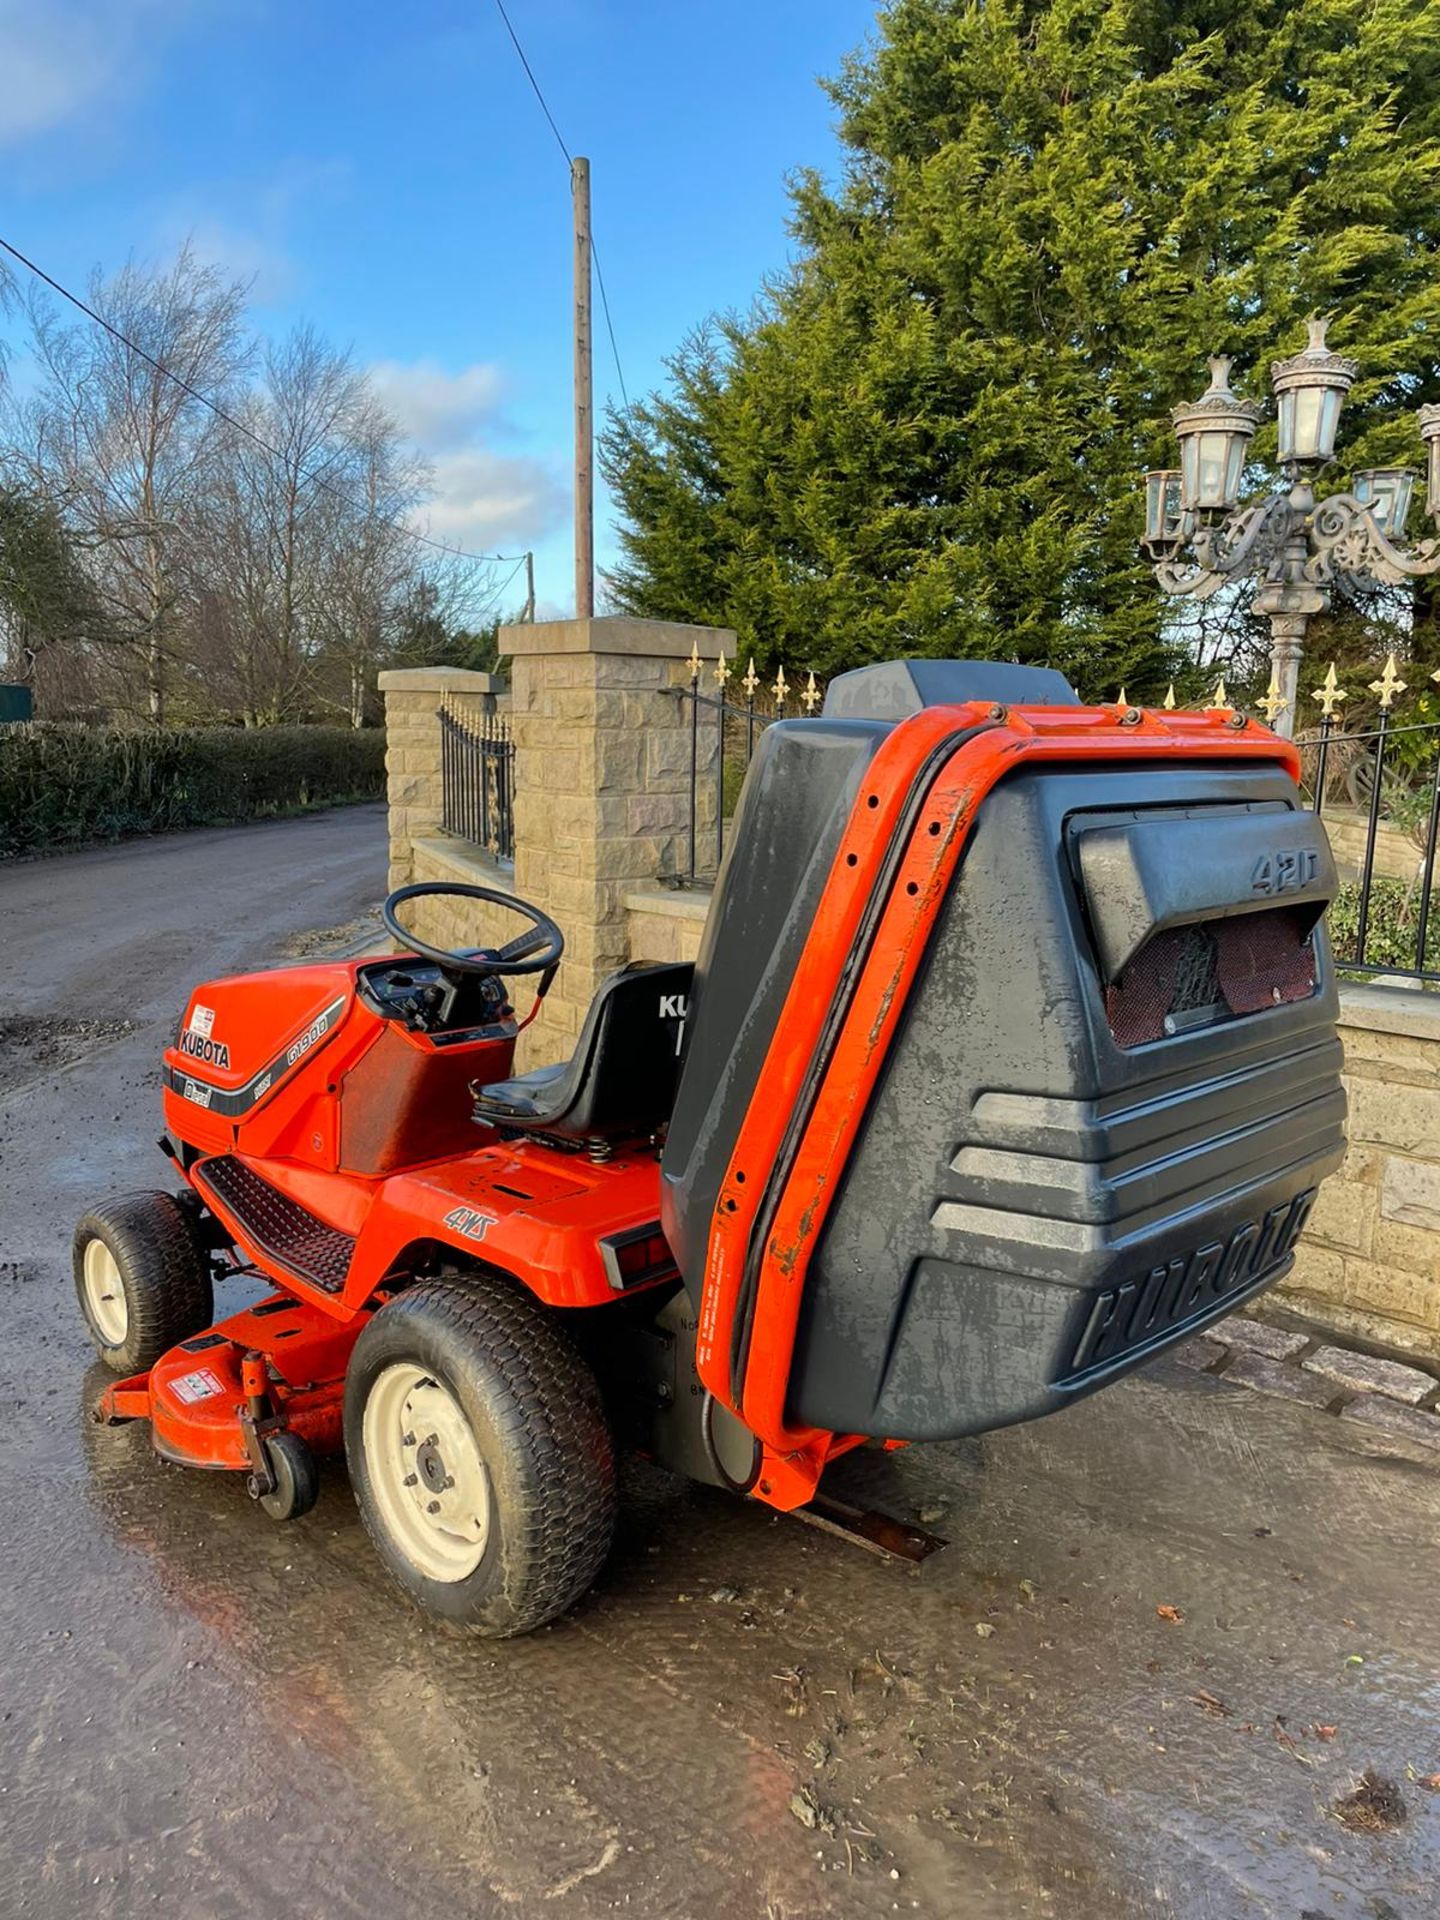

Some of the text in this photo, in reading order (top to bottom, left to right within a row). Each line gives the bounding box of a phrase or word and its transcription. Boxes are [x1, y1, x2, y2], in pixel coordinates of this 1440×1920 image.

[180, 1029, 230, 1069] KUBOTA
[287, 1015, 328, 1066] G1900
[184, 1080, 211, 1108] Diesel
[443, 1206, 499, 1241] 4WS
